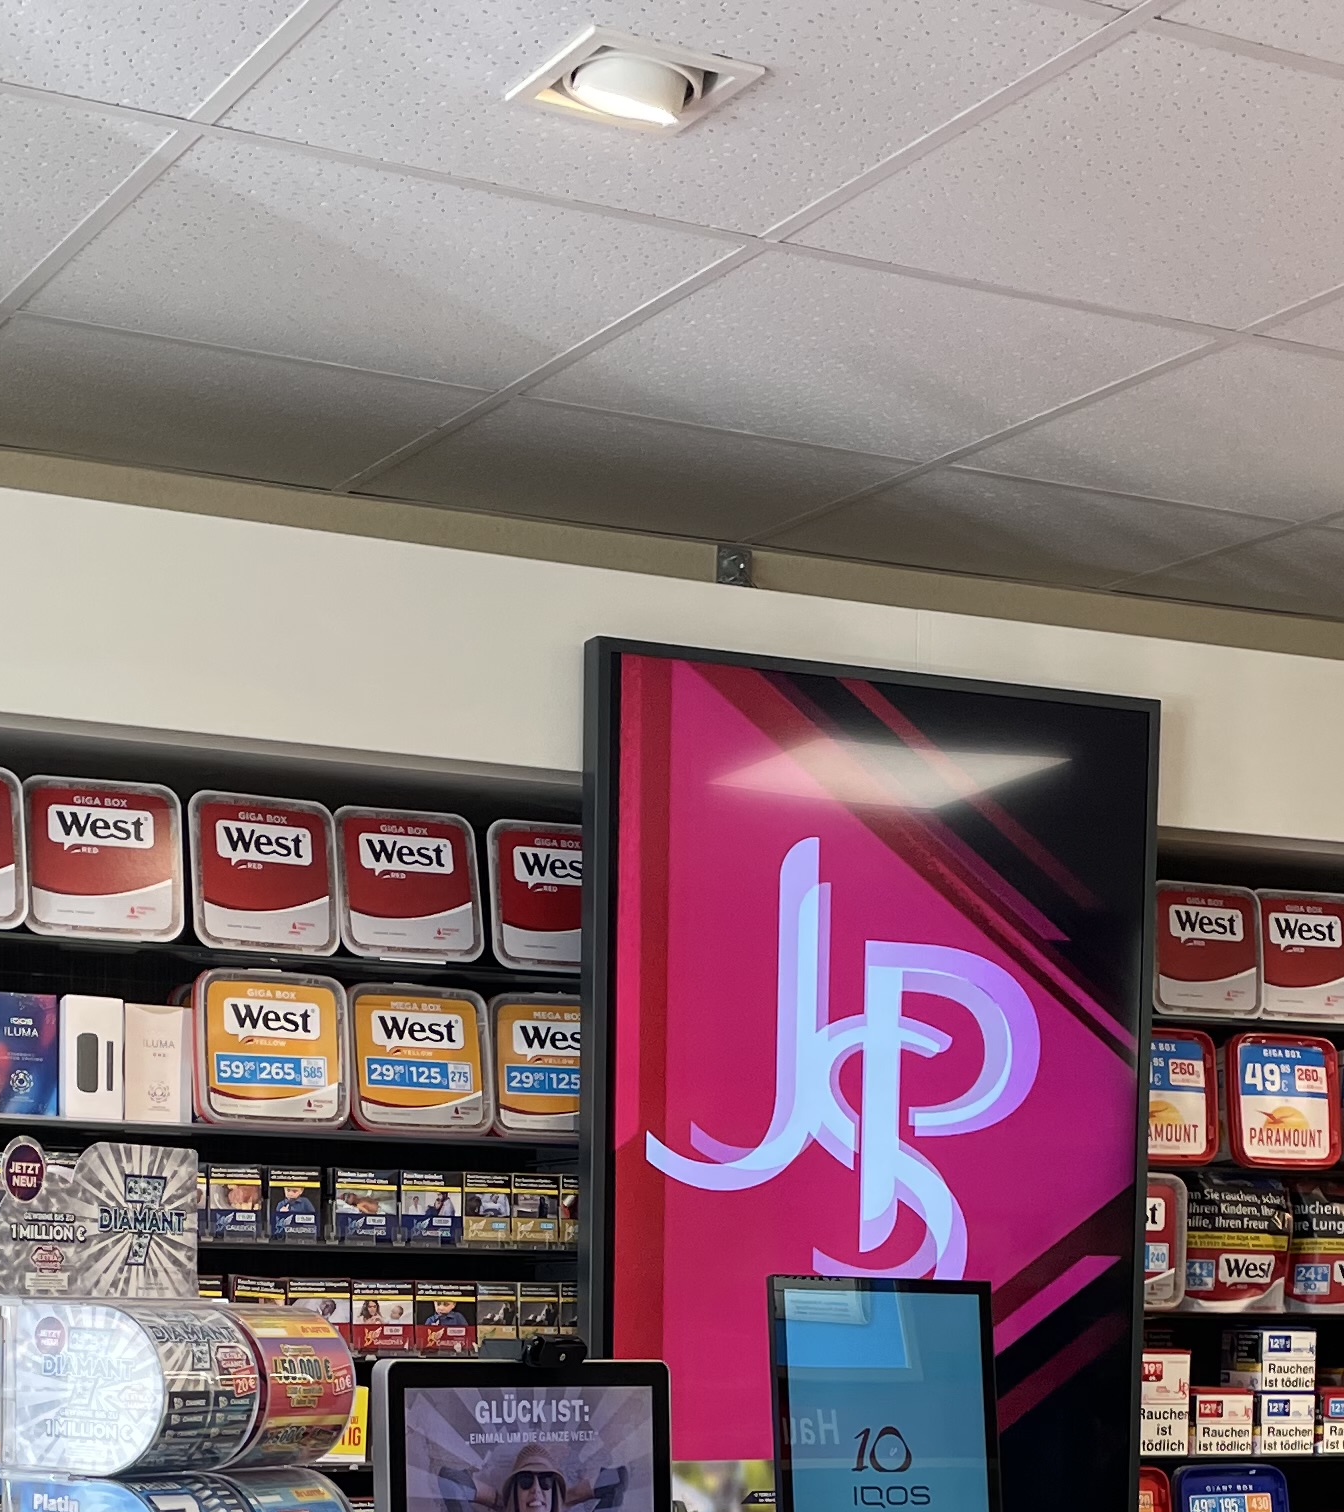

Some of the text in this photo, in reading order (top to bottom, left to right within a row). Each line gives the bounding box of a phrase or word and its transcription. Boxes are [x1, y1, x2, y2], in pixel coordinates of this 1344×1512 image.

[57, 811, 147, 842] West
[224, 826, 306, 859] West
[366, 838, 446, 869] West
[230, 1004, 314, 1034] West
[4, 1027, 38, 1038] ILUMA
[259, 1062, 295, 1080] 265
[1249, 1127, 1322, 1149] PARAMOUNT
[9, 1162, 41, 1174] JETZT
[12, 1176, 36, 1187] NEU!
[98, 1207, 186, 1234] DIAMANT
[10, 1223, 86, 1243] 1 MILLION €
[475, 1395, 590, 1424] GLÜCK IST:
[56, 1420, 118, 1440] MILLION
[507, 1432, 520, 1444] UM
[522, 1431, 537, 1443] DIE
[538, 1431, 569, 1442] GANZE
[1203, 1426, 1250, 1439] Rauchen
[1142, 1439, 1185, 1452] tödlich
[1199, 1439, 1252, 1452] ist tödlich
[853, 1485, 931, 1507] IQOS
